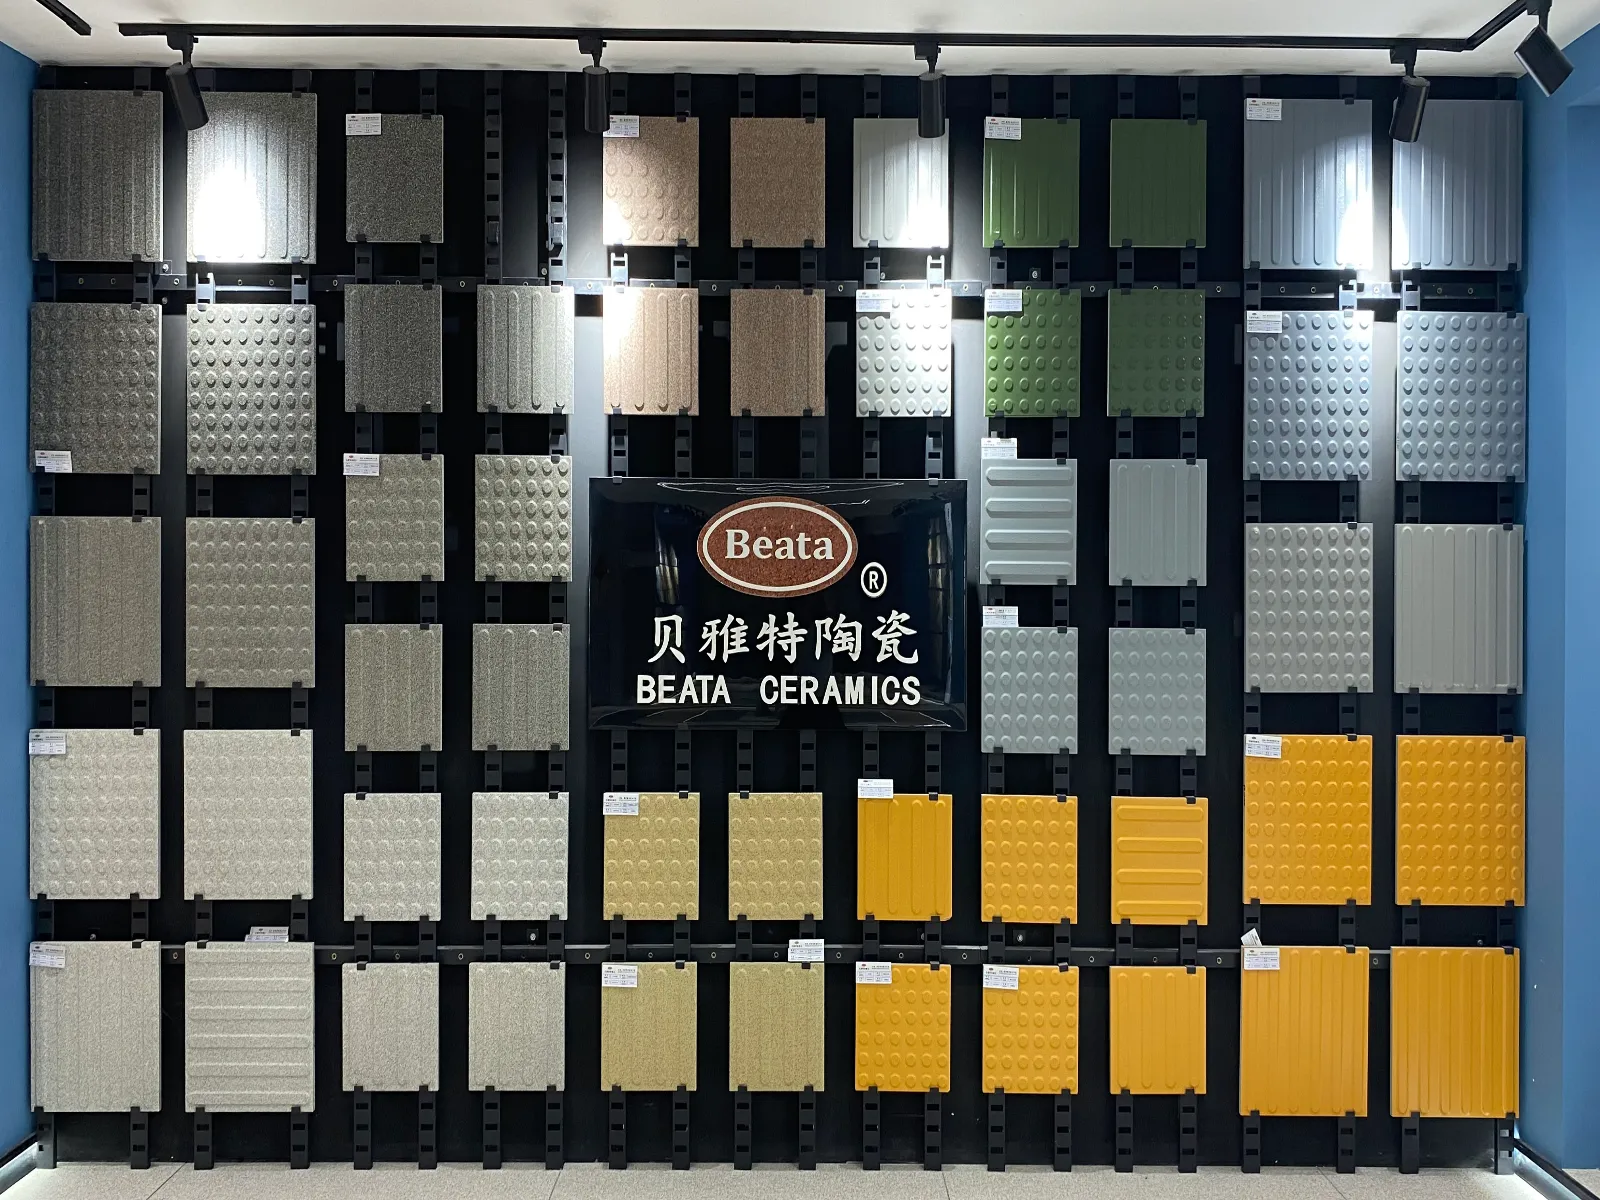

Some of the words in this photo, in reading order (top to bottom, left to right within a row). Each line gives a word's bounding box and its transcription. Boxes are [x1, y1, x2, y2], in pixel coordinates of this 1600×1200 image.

[725, 529, 834, 561] Beata
[647, 610, 919, 664] 贝雅特陶瓷
[636, 674, 732, 704] BEATA
[759, 675, 921, 706] CERAMICS
